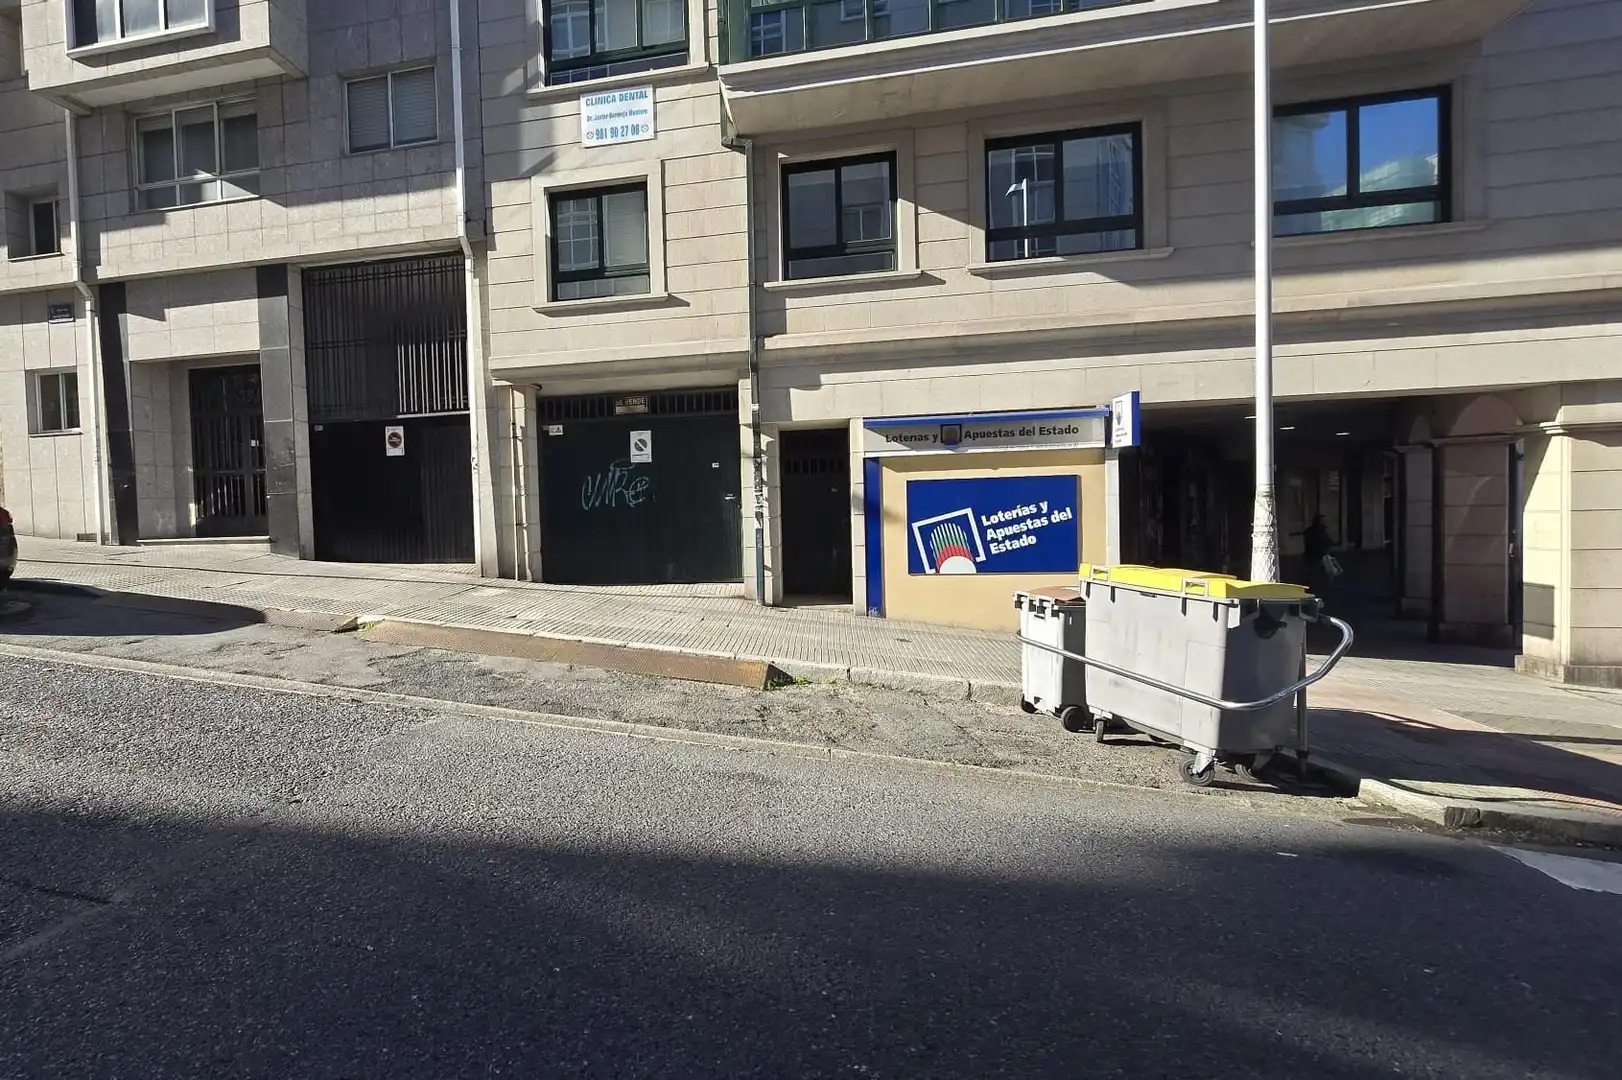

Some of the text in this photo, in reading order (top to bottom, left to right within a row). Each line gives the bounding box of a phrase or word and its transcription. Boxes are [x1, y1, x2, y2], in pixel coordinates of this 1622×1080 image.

[619, 90, 649, 102] DENTAL
[595, 128, 608, 140] 981
[620, 125, 629, 137] 27
[624, 397, 646, 405] VENDE
[932, 433, 938, 443] y
[963, 428, 1016, 440] Apuestas
[1019, 426, 1036, 437] del
[1039, 424, 1079, 436] Estado
[981, 501, 1048, 527] Loterías y
[986, 506, 1073, 541] Apuestas del
[989, 534, 1037, 555] Estado
